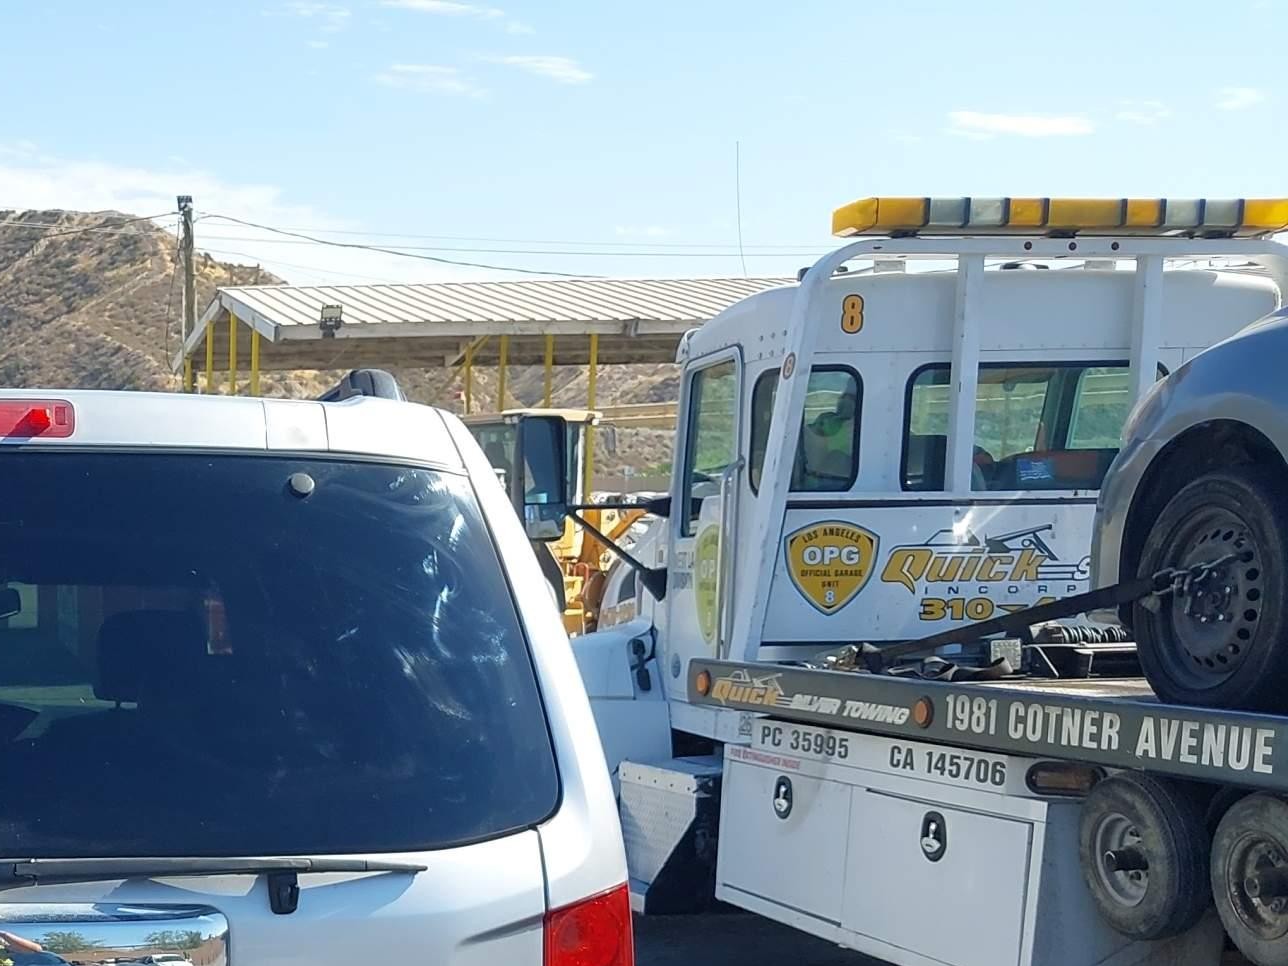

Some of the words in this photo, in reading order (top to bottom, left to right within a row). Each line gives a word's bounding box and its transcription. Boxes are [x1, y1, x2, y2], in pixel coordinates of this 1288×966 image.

[841, 294, 864, 334] 8
[783, 352, 796, 380] 8
[802, 530, 819, 544] LOS
[822, 528, 862, 543] ANGELES
[802, 545, 860, 566] OPG
[800, 569, 832, 577] OFFICIAL
[834, 569, 863, 577] GARAGE
[881, 548, 1048, 594] Quick
[821, 580, 840, 588] UNIT
[825, 590, 835, 603] 8
[842, 700, 910, 725] TOWING
[945, 694, 997, 735] 1981
[1008, 702, 1121, 751] COTNER
[1134, 716, 1276, 774] AVENUE
[761, 725, 783, 747] PC
[790, 730, 849, 759] 35995
[888, 745, 915, 771] CA
[925, 751, 1006, 786] 145706
